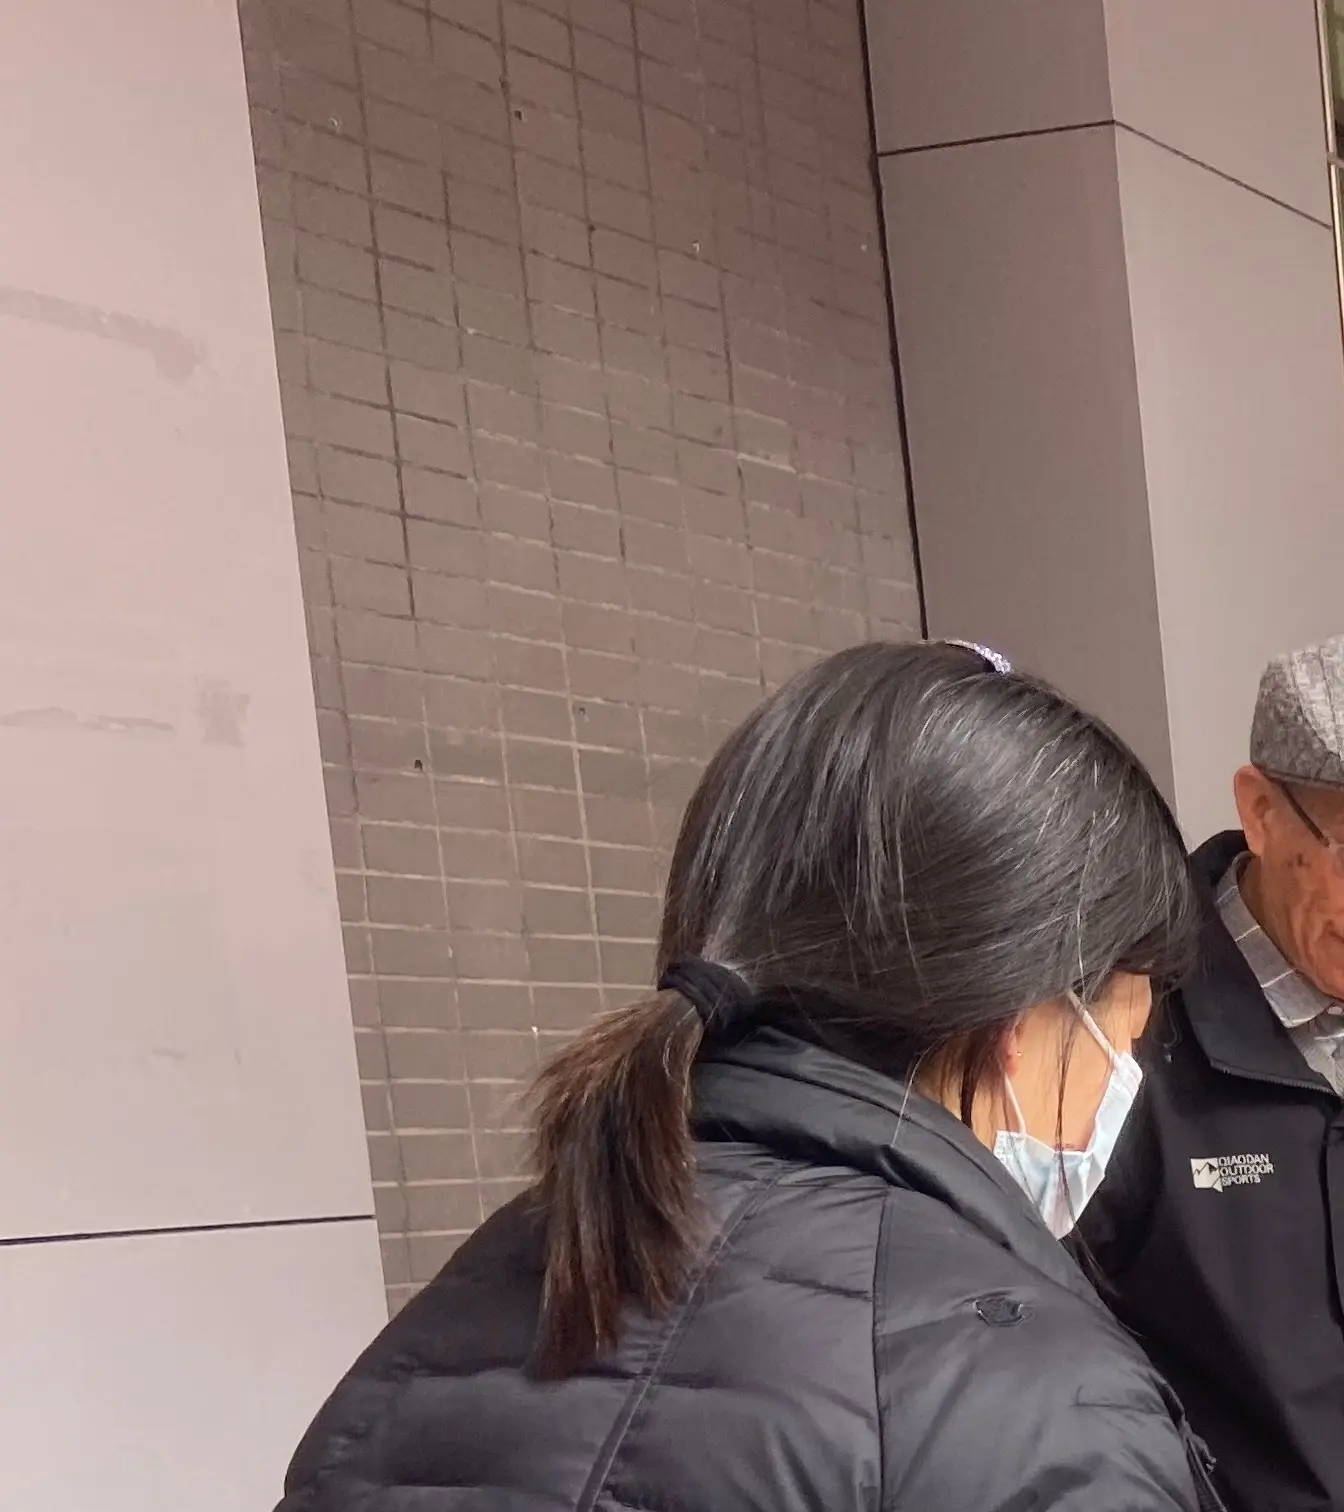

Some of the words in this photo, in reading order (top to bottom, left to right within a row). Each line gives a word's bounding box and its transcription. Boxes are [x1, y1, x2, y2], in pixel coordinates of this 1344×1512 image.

[1219, 1154, 1270, 1166] QIAODAN
[1220, 1163, 1274, 1176] OUTDOOR
[1221, 1174, 1261, 1186] SPORTS
